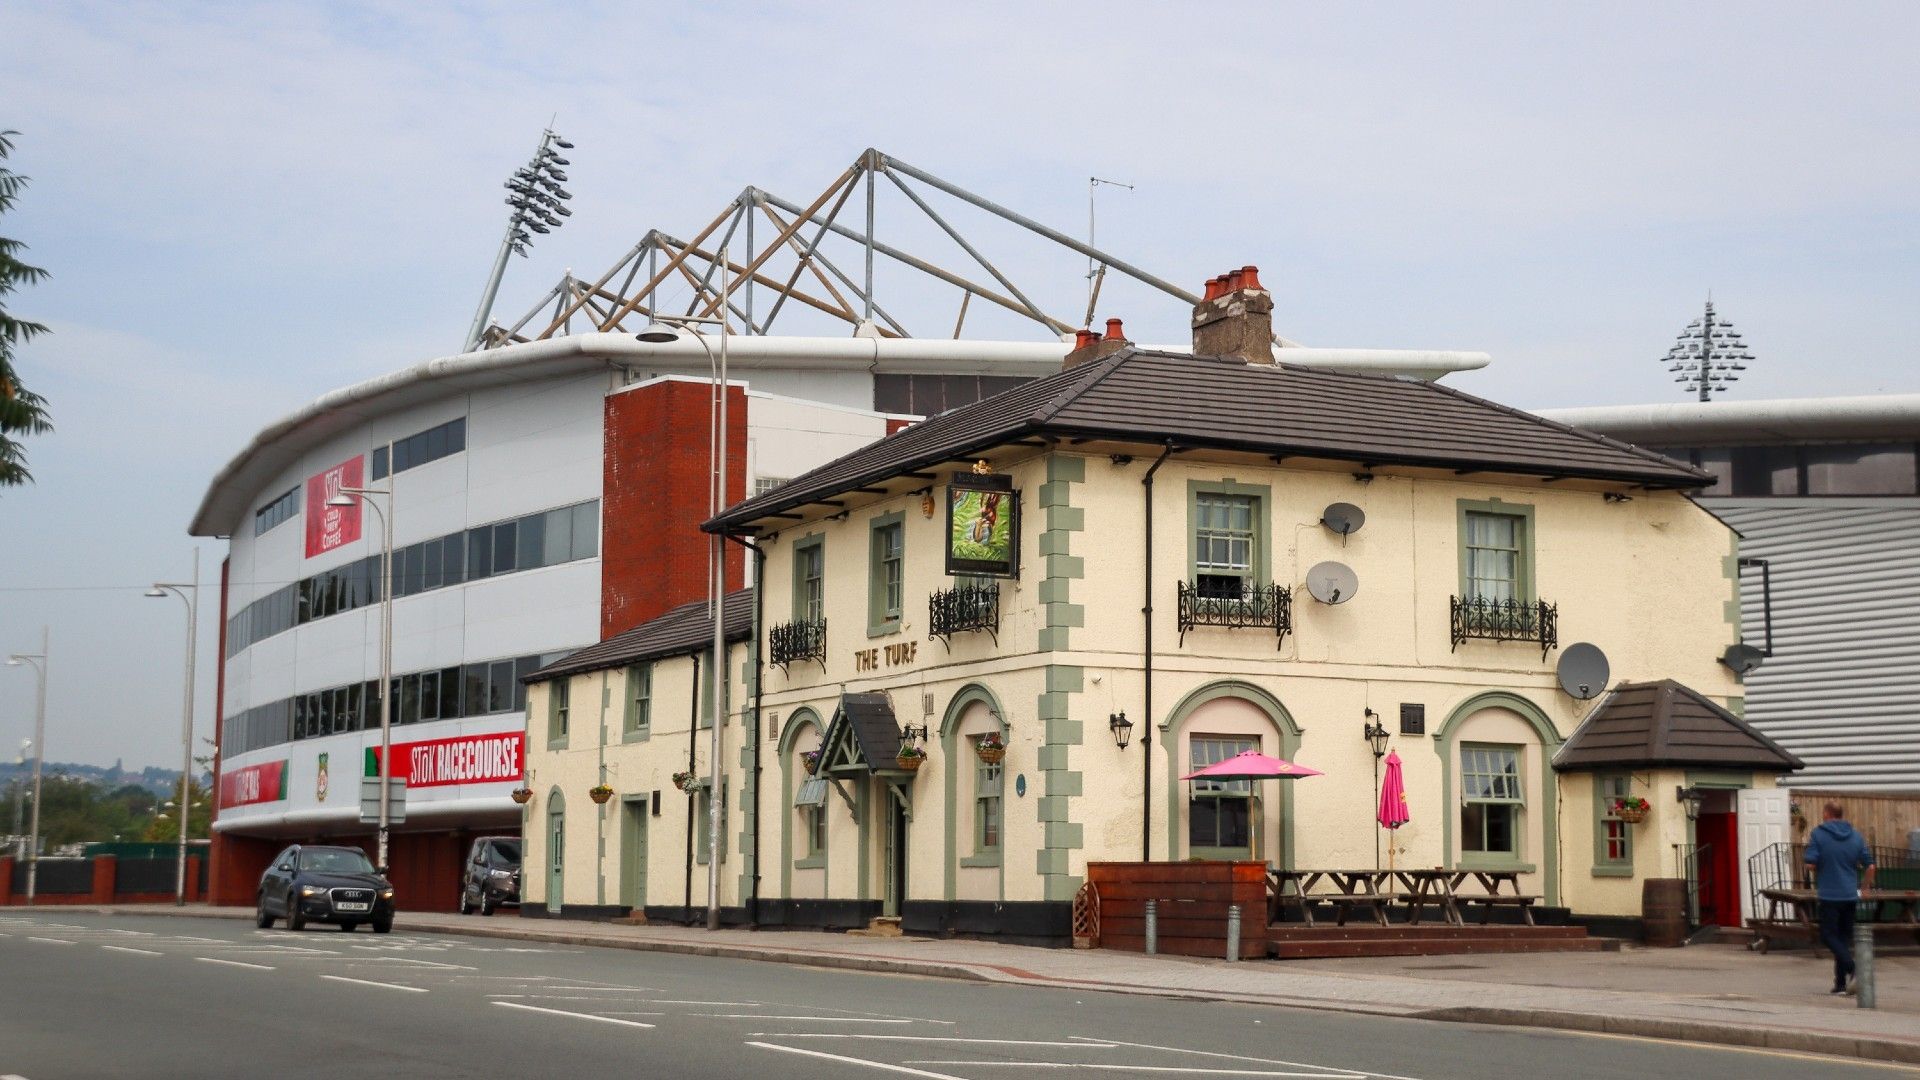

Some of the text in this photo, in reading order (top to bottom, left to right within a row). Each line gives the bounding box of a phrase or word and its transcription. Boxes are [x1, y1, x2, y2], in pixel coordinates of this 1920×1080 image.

[854, 640, 918, 673] THE TURF
[437, 737, 520, 781] RACECOURSE
